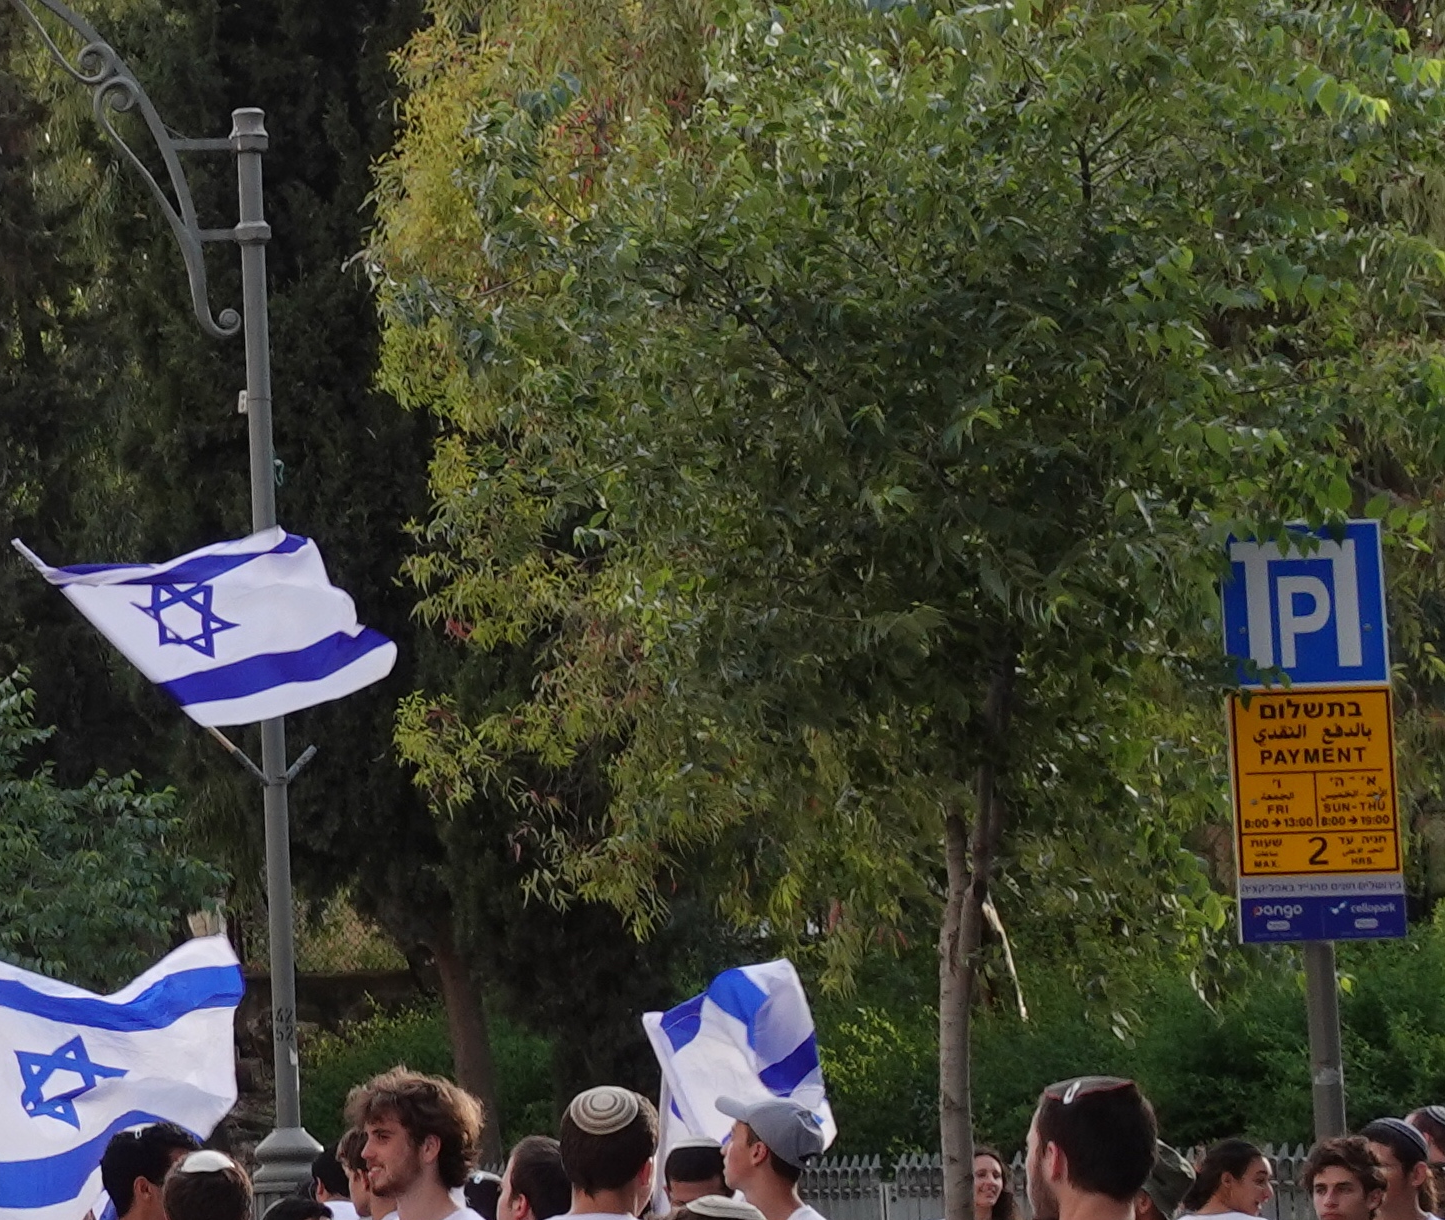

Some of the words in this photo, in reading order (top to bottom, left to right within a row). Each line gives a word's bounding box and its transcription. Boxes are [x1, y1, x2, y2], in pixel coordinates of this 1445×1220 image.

[1260, 699, 1362, 720] בתשלום
[1260, 746, 1367, 765] PAYMENT
[1267, 804, 1289, 814] FRI
[1308, 836, 1329, 866] 2
[1252, 903, 1304, 919] pango
